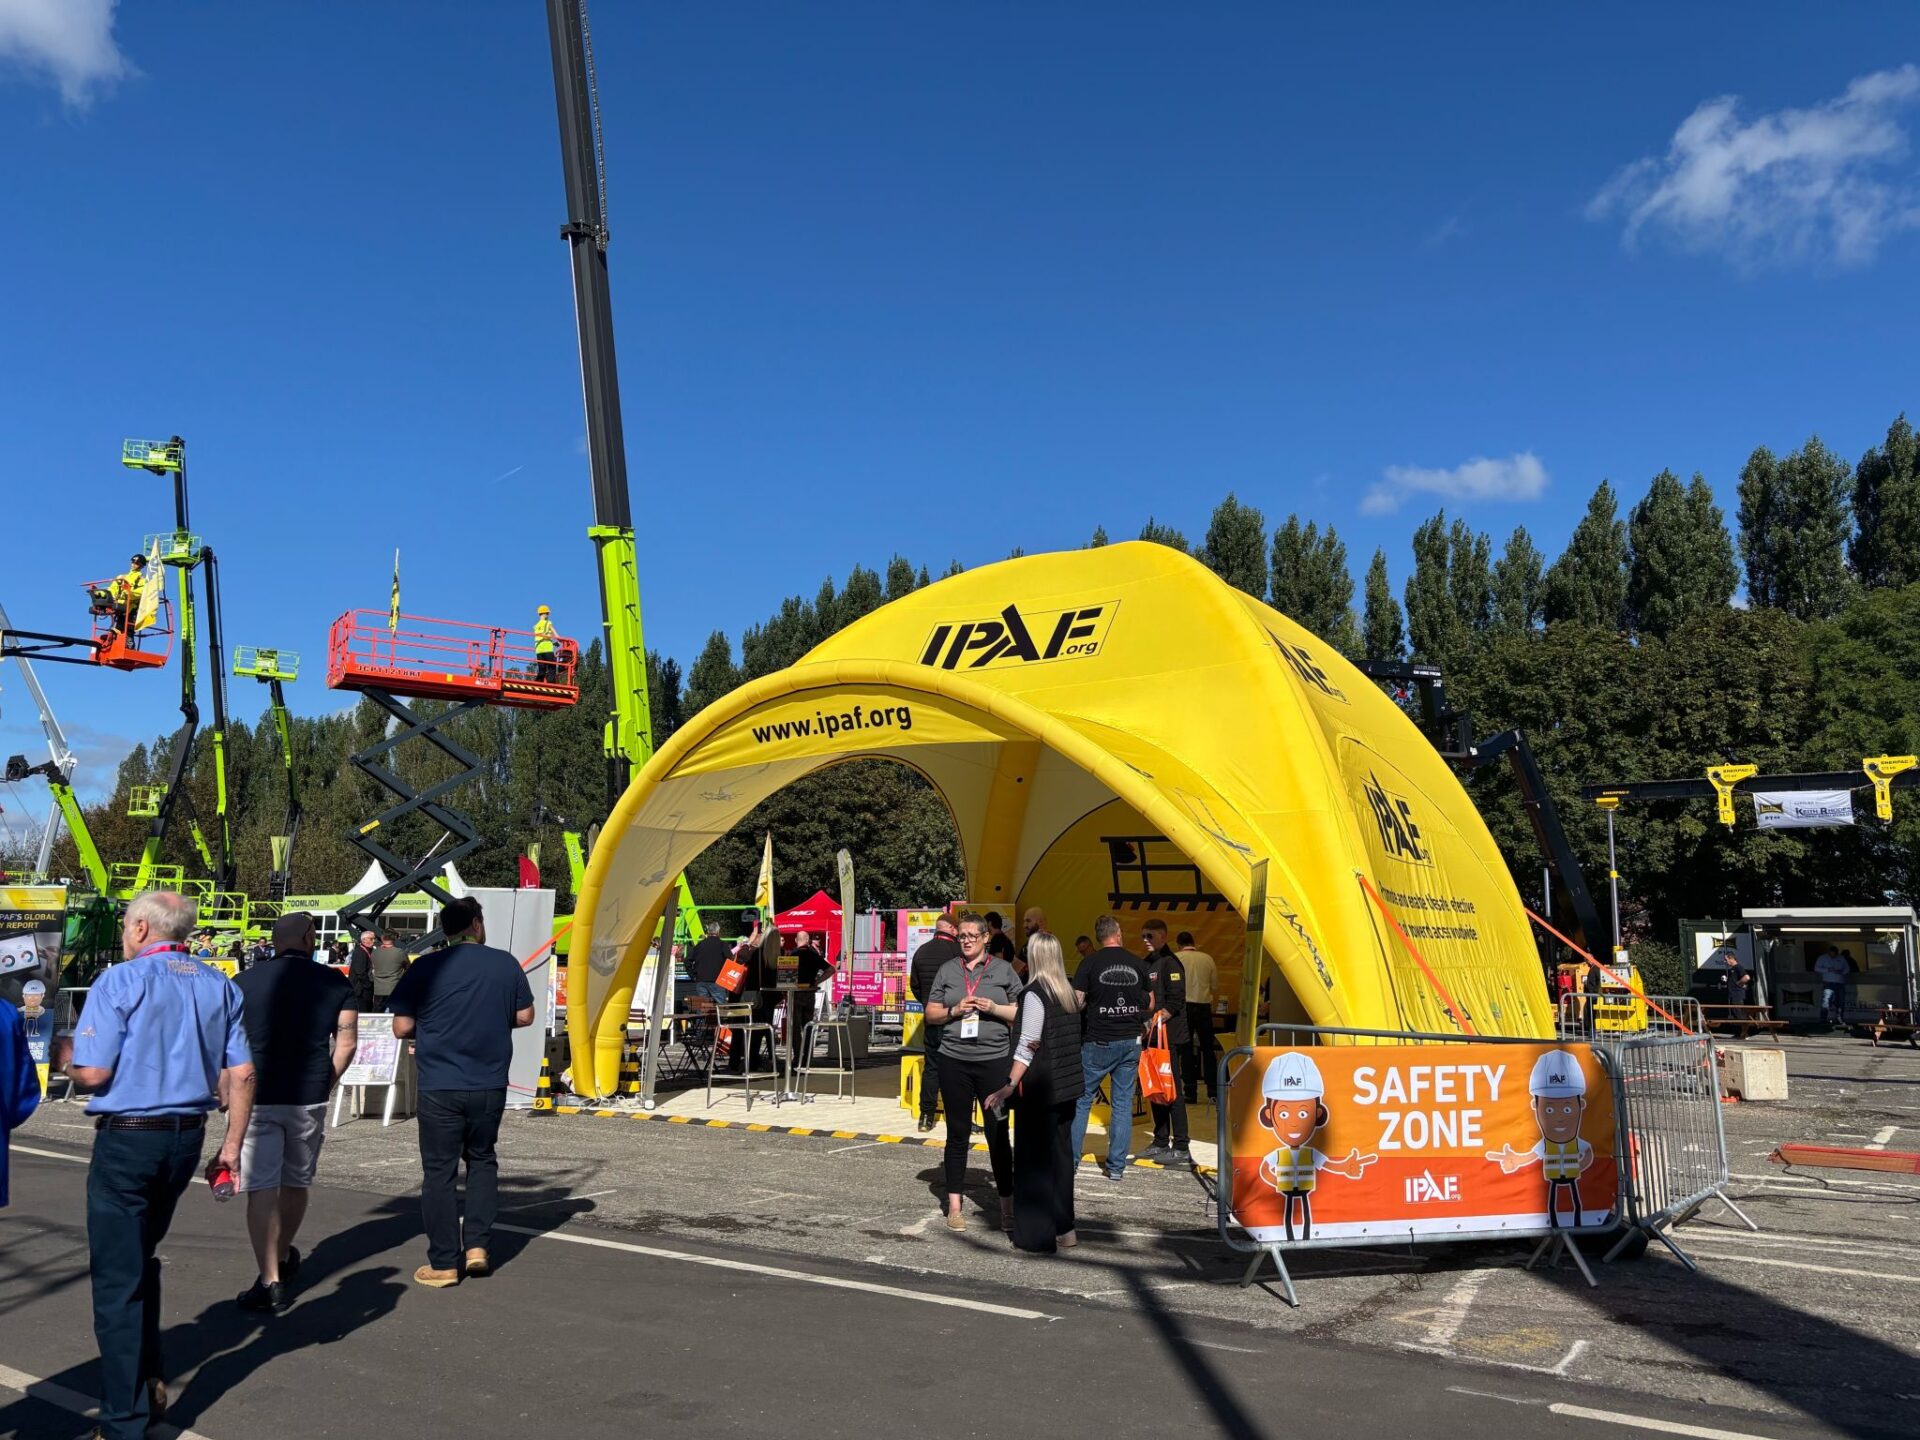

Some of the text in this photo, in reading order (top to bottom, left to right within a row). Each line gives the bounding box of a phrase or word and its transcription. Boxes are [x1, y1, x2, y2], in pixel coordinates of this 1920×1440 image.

[920, 604, 1103, 670] IPAF .org
[752, 704, 912, 743] www.ipaf.org
[1363, 768, 1424, 860] IPAF
[1795, 807, 1818, 816] KEITH
[24, 913, 57, 921] GLOBAL
[1100, 1005, 1140, 1014] PATROL
[1284, 1075, 1302, 1086] IPAF
[1352, 1065, 1506, 1105] SAFETY
[1549, 1073, 1566, 1084] IPAF
[1378, 1109, 1484, 1150] ZONE
[1405, 1168, 1458, 1202] IPAF
